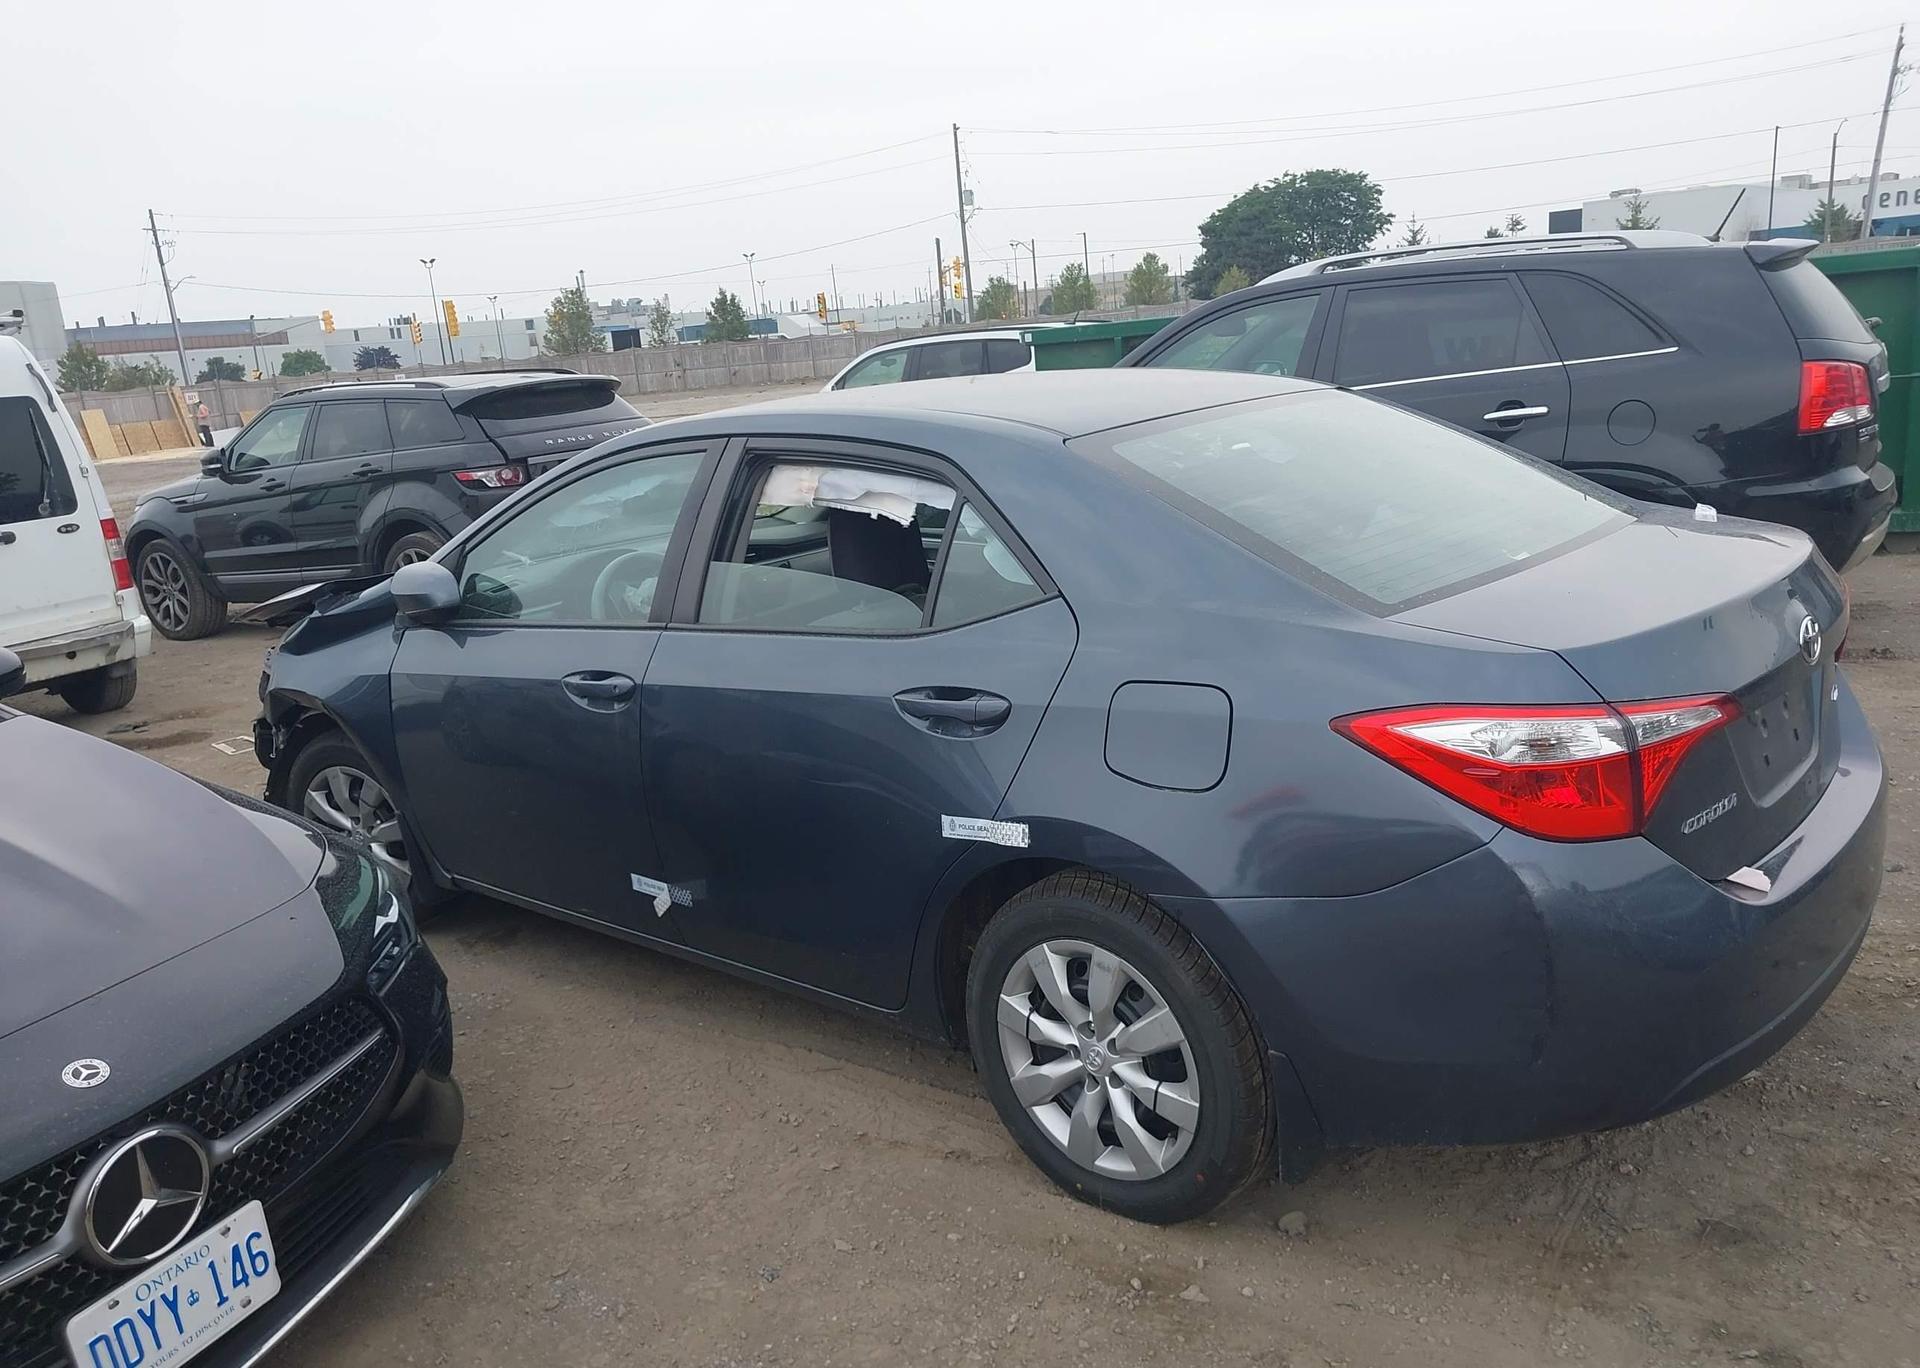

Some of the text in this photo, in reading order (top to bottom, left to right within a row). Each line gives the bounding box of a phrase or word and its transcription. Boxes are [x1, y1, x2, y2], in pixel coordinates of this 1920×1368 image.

[544, 434, 594, 445] RANGE
[958, 823, 976, 832] POLICE
[1681, 792, 1737, 834] COROLLA
[135, 1244, 211, 1302] ONTARIO
[88, 1231, 270, 1368] DDYY 146
[182, 1333, 195, 1348] TO
[195, 1304, 236, 1340] DISCOVER
